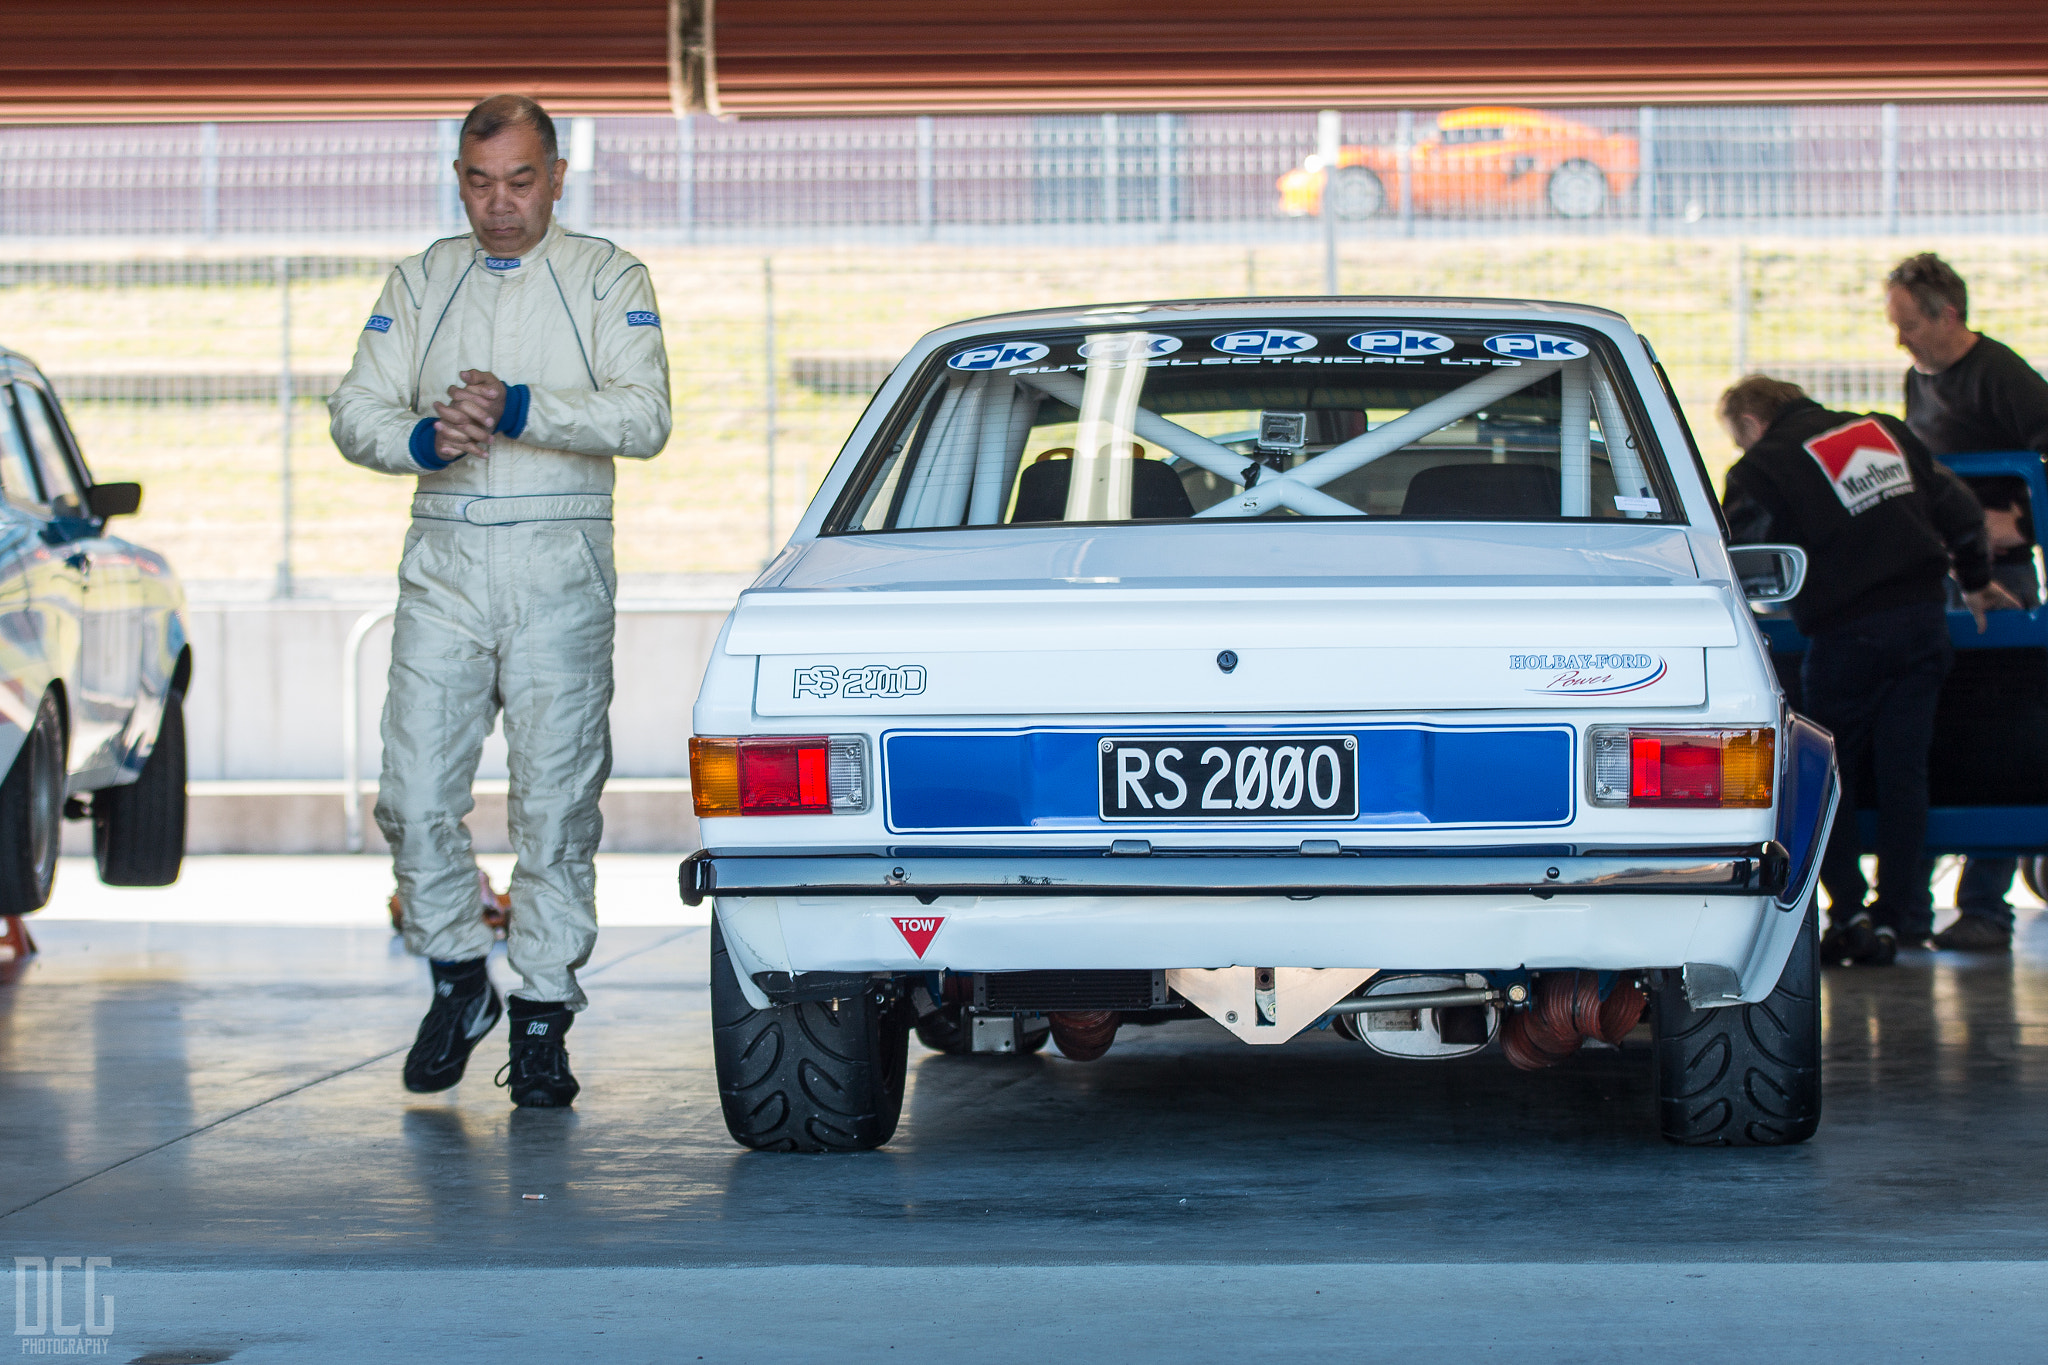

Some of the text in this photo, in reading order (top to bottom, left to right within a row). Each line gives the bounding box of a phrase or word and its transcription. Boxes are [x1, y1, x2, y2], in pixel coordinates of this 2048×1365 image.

[1090, 337, 1173, 358] PK
[1223, 335, 1306, 351] PK
[1361, 335, 1442, 351] PK
[1496, 338, 1577, 355] PK
[957, 346, 1039, 368] PK
[1009, 356, 1522, 376] AUTO ELECTRICAL LTD
[1509, 653, 1651, 670] HOLBAY-FORD
[793, 664, 928, 699] RS 2000
[1546, 670, 1615, 689] Power
[1117, 747, 1188, 810] RS
[898, 919, 936, 932] TOW
